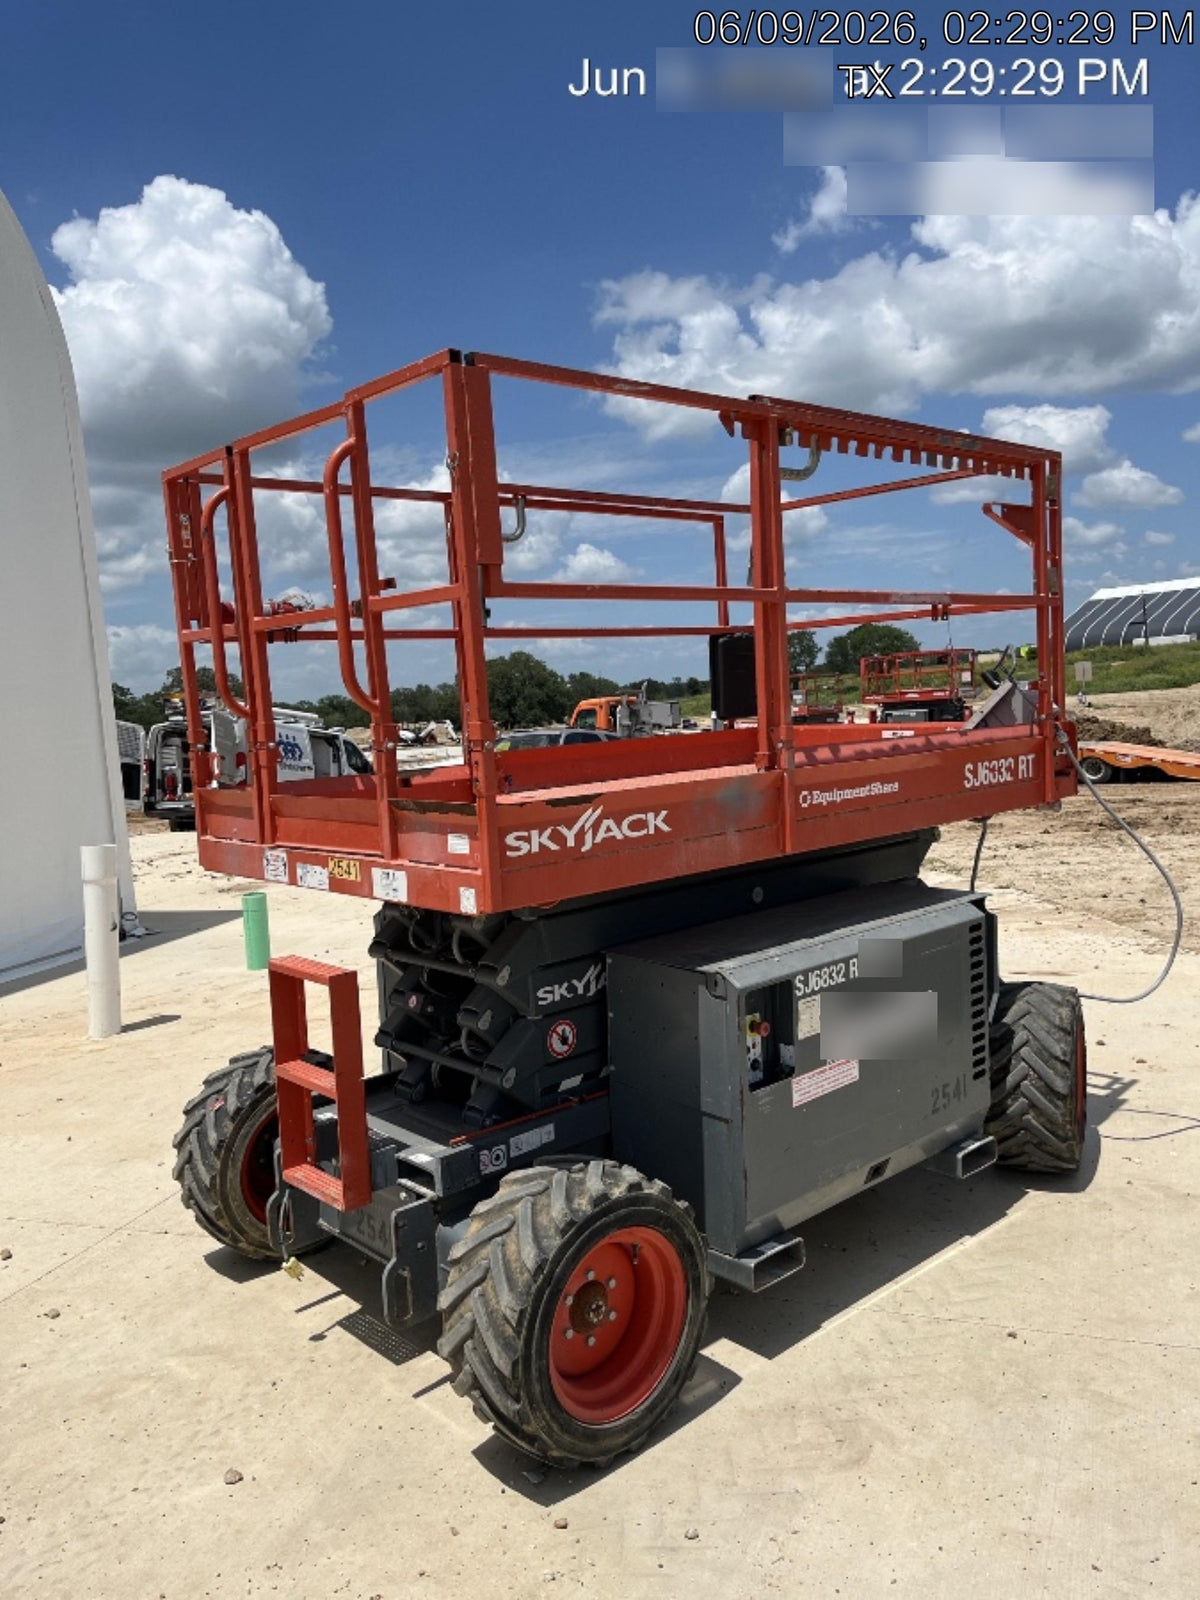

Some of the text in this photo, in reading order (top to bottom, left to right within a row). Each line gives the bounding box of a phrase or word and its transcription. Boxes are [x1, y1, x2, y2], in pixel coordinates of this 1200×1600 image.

[1018, 754, 1035, 779] RT
[504, 805, 671, 858] SKYJACK
[328, 857, 360, 879] 2541
[795, 965, 846, 997] SJ6832
[930, 1073, 968, 1115] 2541
